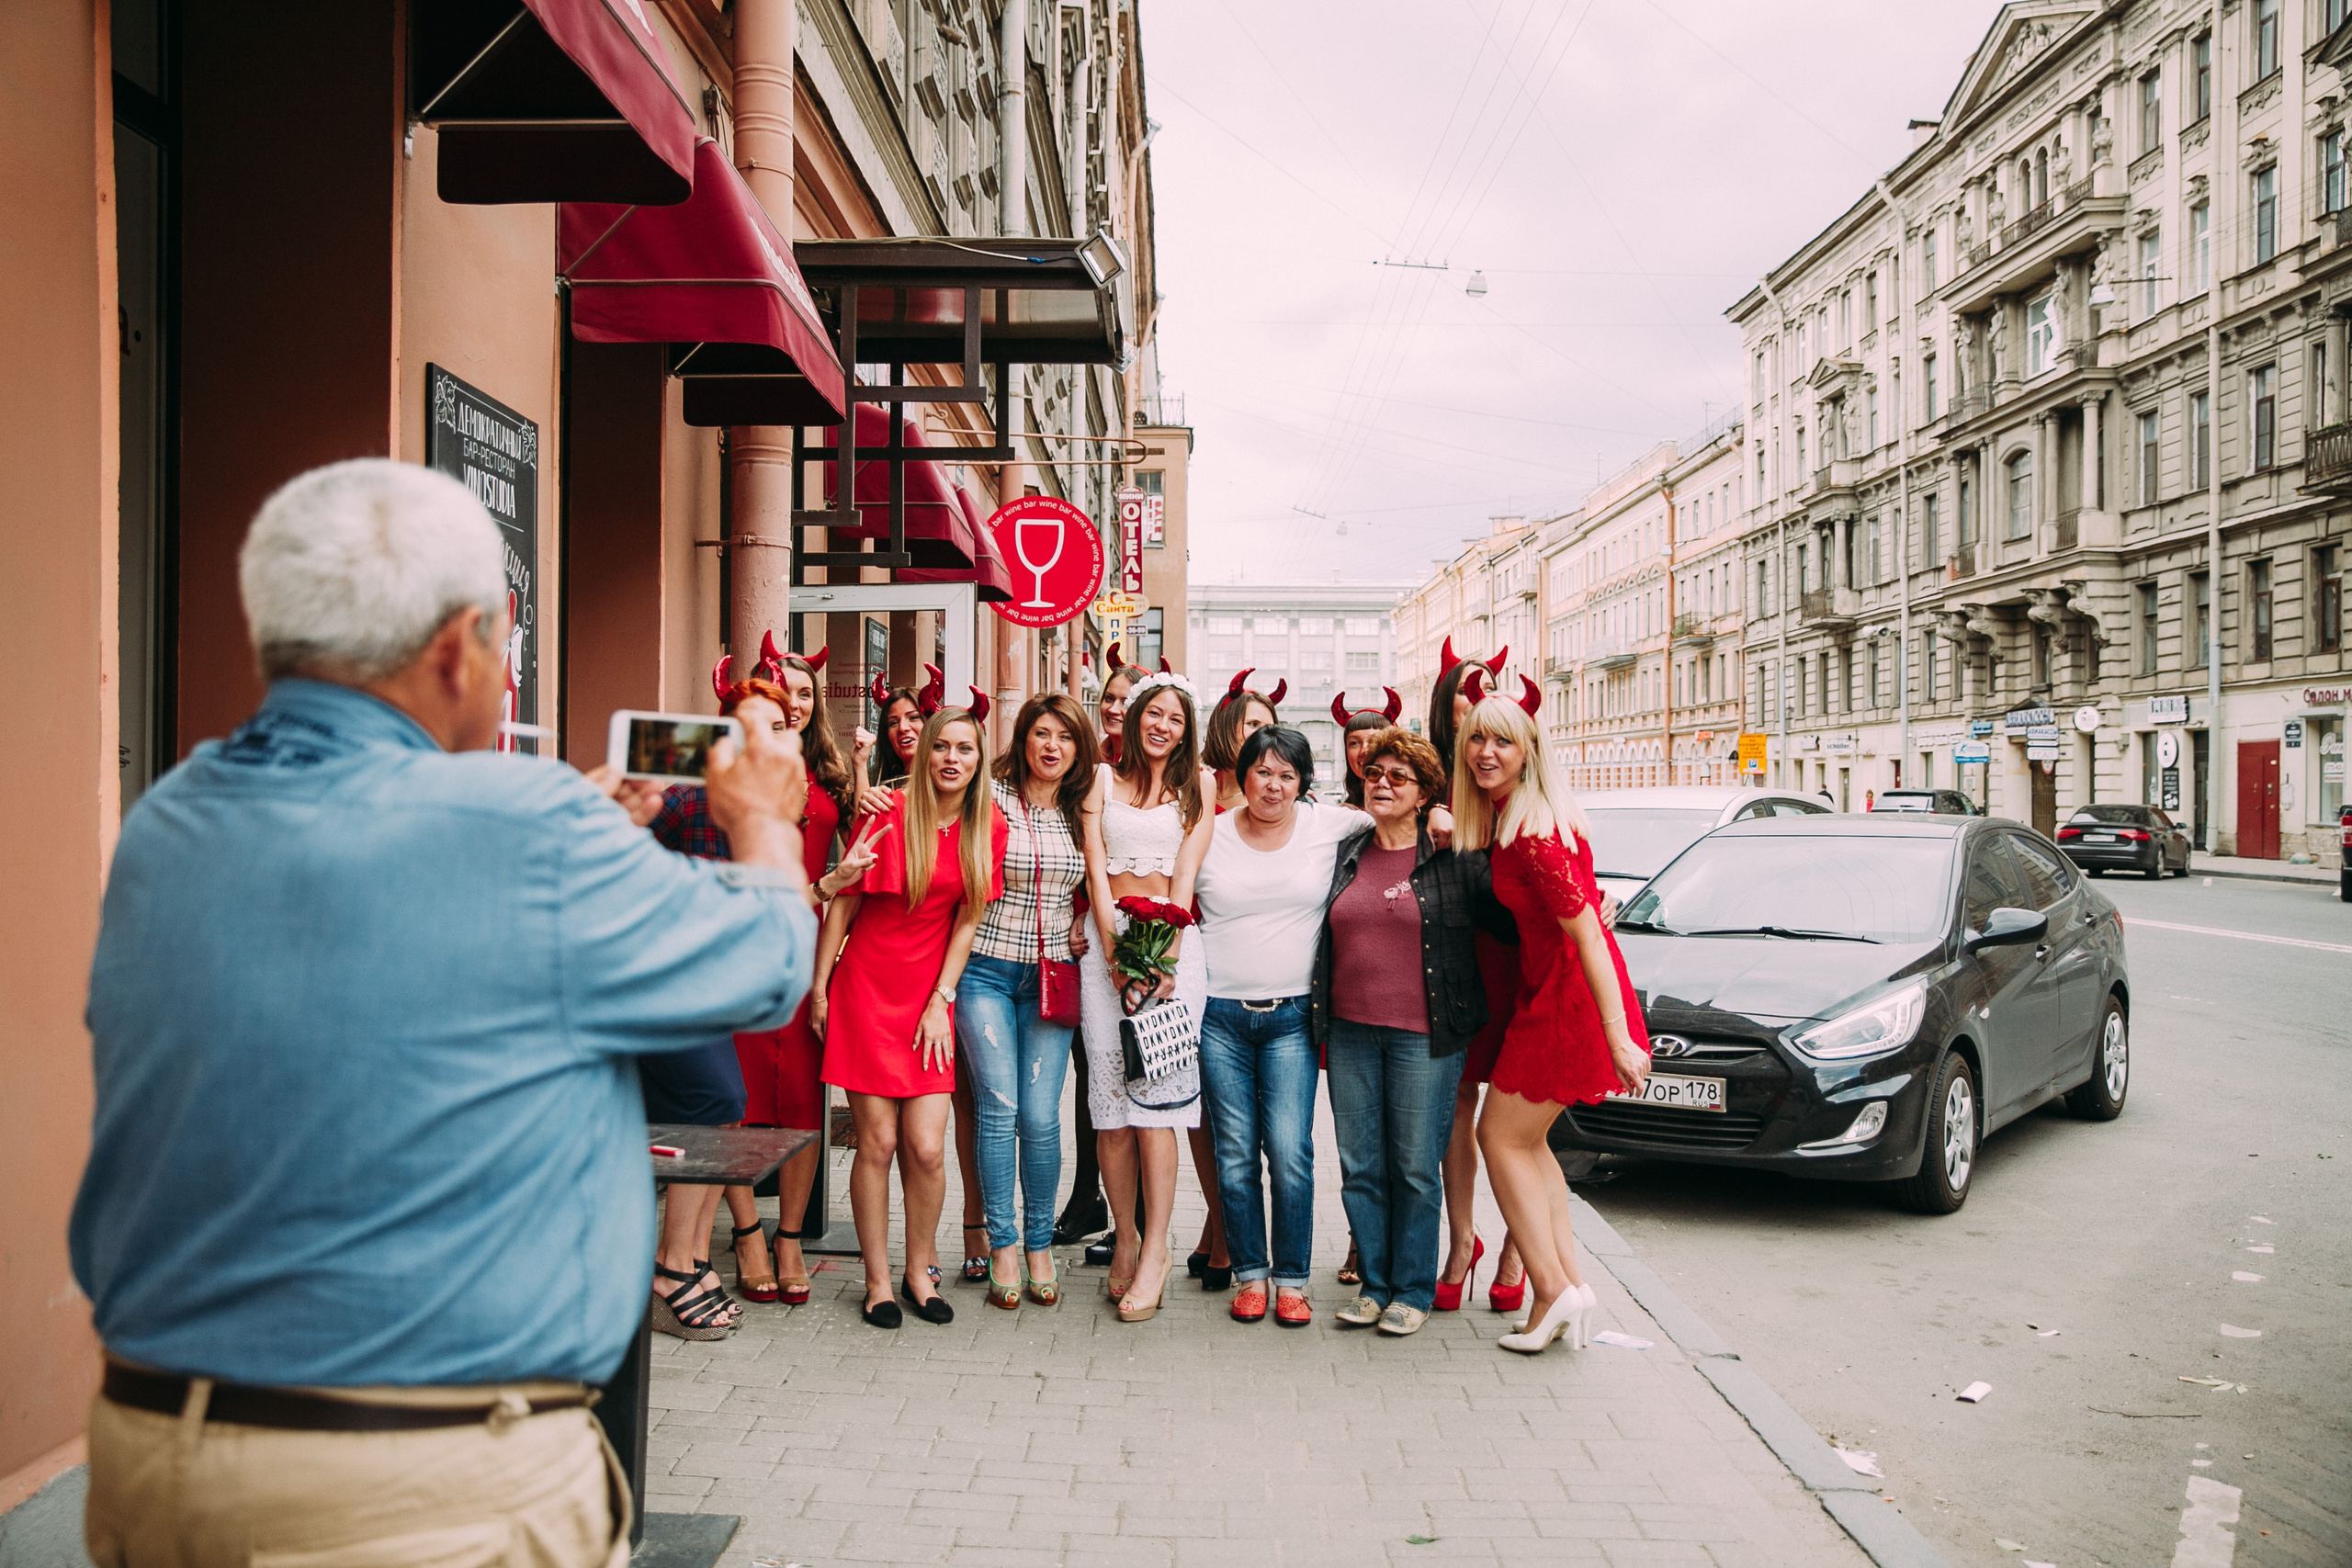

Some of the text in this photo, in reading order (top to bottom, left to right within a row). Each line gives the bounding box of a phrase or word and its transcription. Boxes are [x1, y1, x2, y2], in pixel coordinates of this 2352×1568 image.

[463, 436, 515, 479] БАР-РЕСТОРАН
[1004, 504, 1023, 517] wine
[1023, 501, 1037, 509] bar
[1039, 501, 1057, 510] wine
[1058, 503, 1072, 515] bar
[992, 514, 1004, 527] bar
[1071, 513, 1088, 529] wine
[1085, 527, 1095, 542] bar
[1091, 542, 1100, 562] wine
[1122, 502, 1141, 592] ОТЕЛЬ
[1092, 563, 1101, 578] bar
[1083, 579, 1096, 597] wine
[1074, 595, 1087, 609] bar
[1096, 603, 1135, 614] Санта
[1006, 607, 1020, 619] bar
[1021, 614, 1039, 623] wine
[1040, 614, 1055, 622] bar
[1056, 606, 1074, 618] wine
[2303, 689, 2338, 703] Салон
[1143, 1019, 1194, 1050] DKNYDKNY
[1685, 1081, 1717, 1100] 178
[1692, 1099, 1709, 1108] RUS
